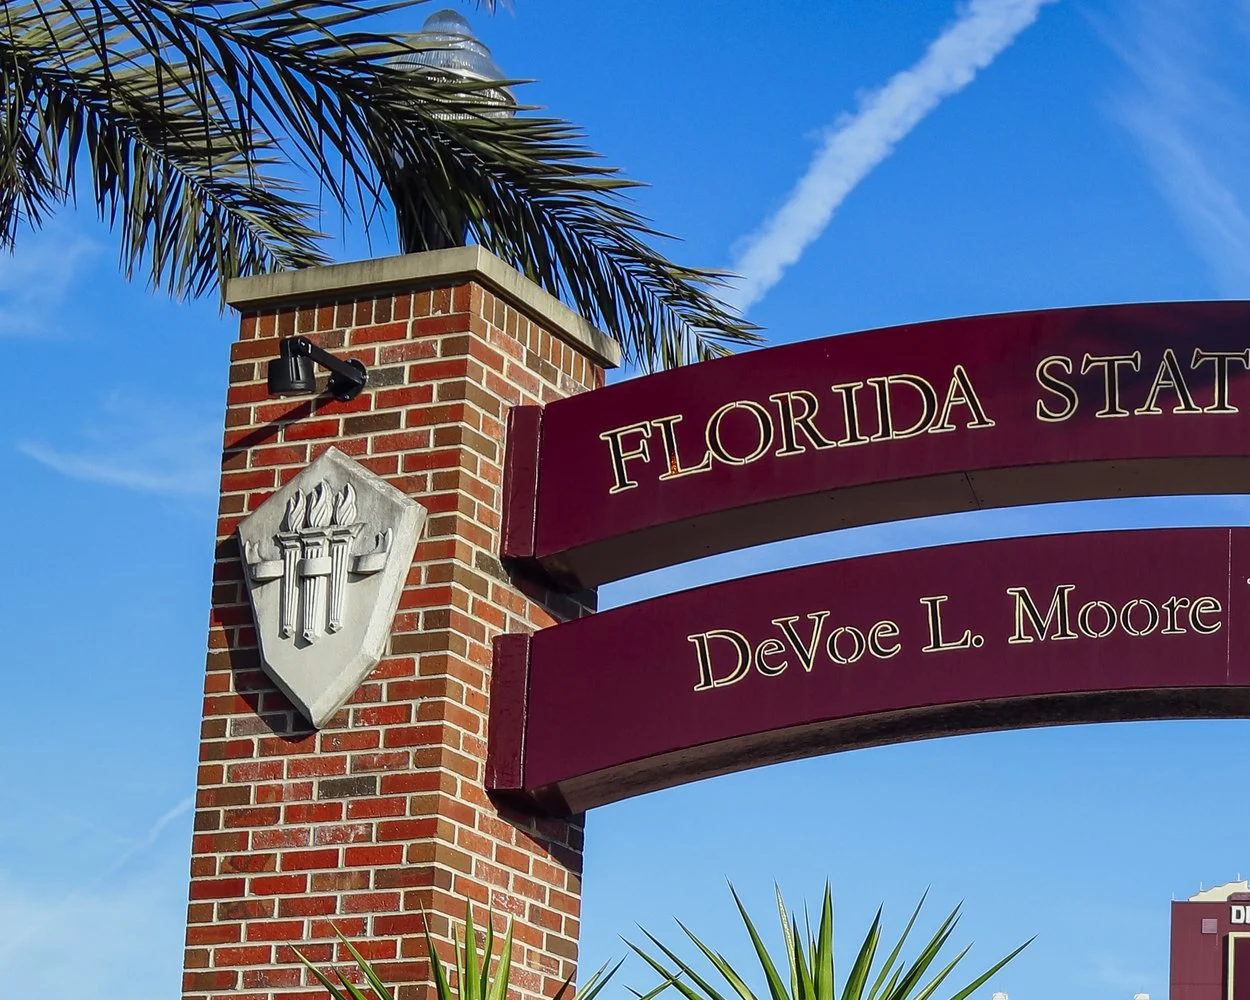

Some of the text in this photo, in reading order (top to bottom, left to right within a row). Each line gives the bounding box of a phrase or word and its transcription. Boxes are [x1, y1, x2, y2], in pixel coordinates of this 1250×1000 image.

[599, 365, 995, 494] FLORIDA
[687, 610, 901, 692] DeVoe
[920, 595, 984, 654] L.
[1008, 584, 1222, 645] Moore
